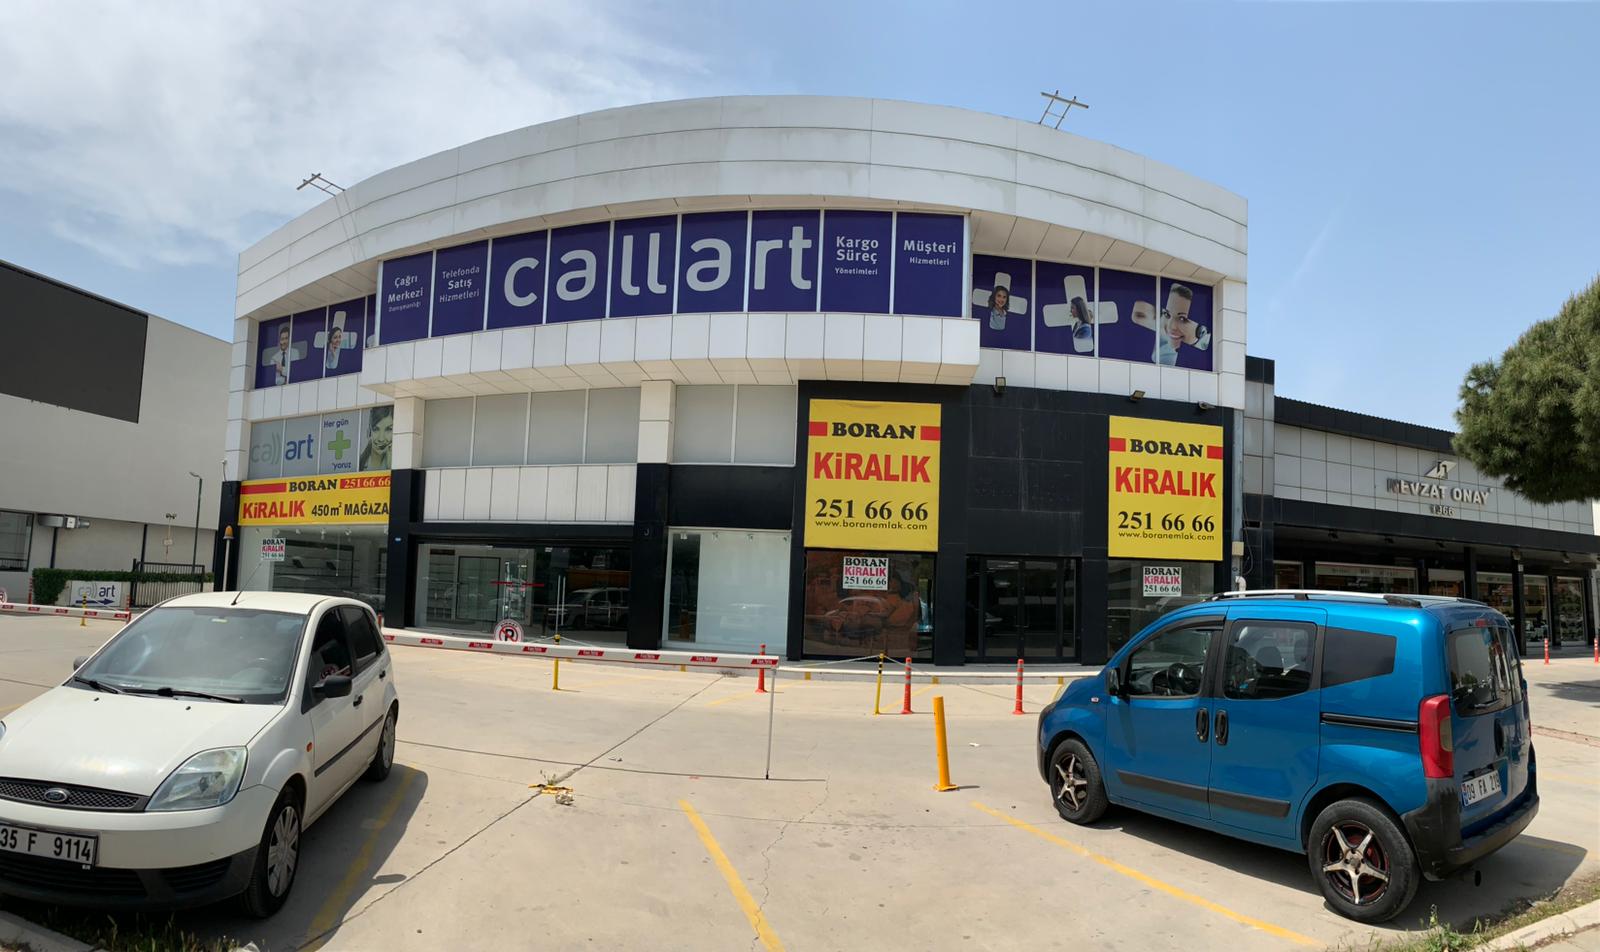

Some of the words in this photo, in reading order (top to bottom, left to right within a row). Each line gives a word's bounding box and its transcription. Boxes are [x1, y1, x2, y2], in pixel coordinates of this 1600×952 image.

[836, 236, 879, 251] Kargo
[903, 239, 957, 255] Müşteri
[836, 249, 878, 264] Süreç
[909, 257, 950, 266] Hizmetleri
[442, 266, 480, 280] Telefonda
[834, 267, 878, 276] Yönetimleri
[394, 274, 418, 289] Çağrı
[447, 278, 473, 290] Satış
[388, 287, 423, 304] Merkezi
[439, 289, 480, 304] Hizmetleri
[323, 419, 335, 429] Her
[336, 418, 349, 429] gün
[831, 422, 916, 440] BORAN
[1130, 438, 1204, 458] BORAN
[288, 479, 338, 493] BORAN
[344, 479, 362, 489] 251
[363, 477, 376, 488] 66
[378, 476, 391, 487] 66
[1451, 487, 1490, 505] ONAY
[344, 500, 389, 516] MAĞAZA
[815, 498, 855, 518] 251
[865, 500, 892, 520] 66
[901, 501, 928, 521] 66
[815, 519, 928, 530] www.boranemlak.com
[1118, 511, 1152, 530] 251
[1161, 513, 1185, 531] 66
[1192, 514, 1215, 532] 66
[1118, 531, 1215, 541] www.boranemlak.com
[845, 558, 887, 567] BORAN
[1144, 567, 1180, 575] BORAN
[844, 576, 859, 584] 251
[862, 577, 873, 585] 66
[876, 577, 887, 585] 66
[0, 828, 18, 849] 35
[28, 833, 38, 852] F
[54, 837, 91, 861] 9114
